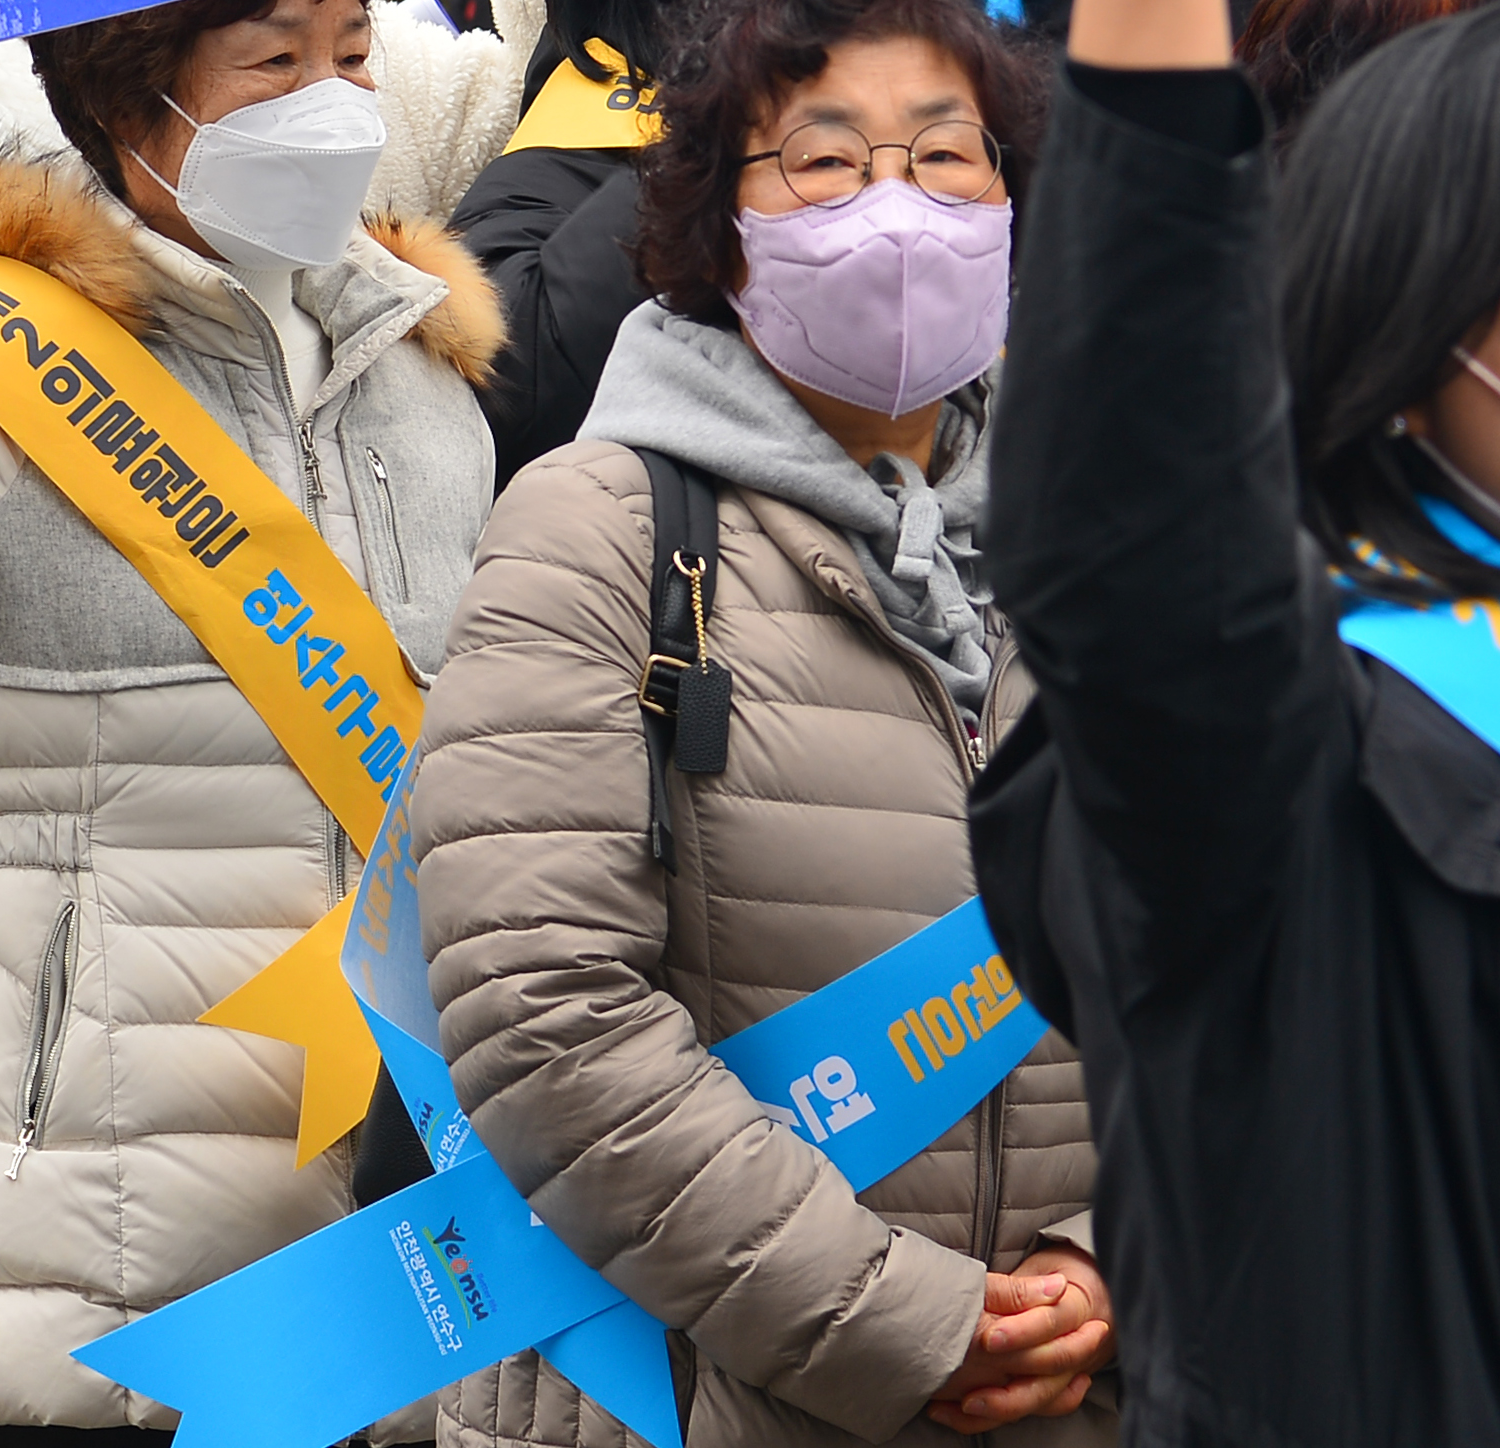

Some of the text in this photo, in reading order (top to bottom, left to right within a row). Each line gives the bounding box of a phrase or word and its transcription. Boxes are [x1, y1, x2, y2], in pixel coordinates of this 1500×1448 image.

[396, 1220, 463, 1353] 인천광역시 연수구
[433, 1215, 490, 1322] Yeonsu
